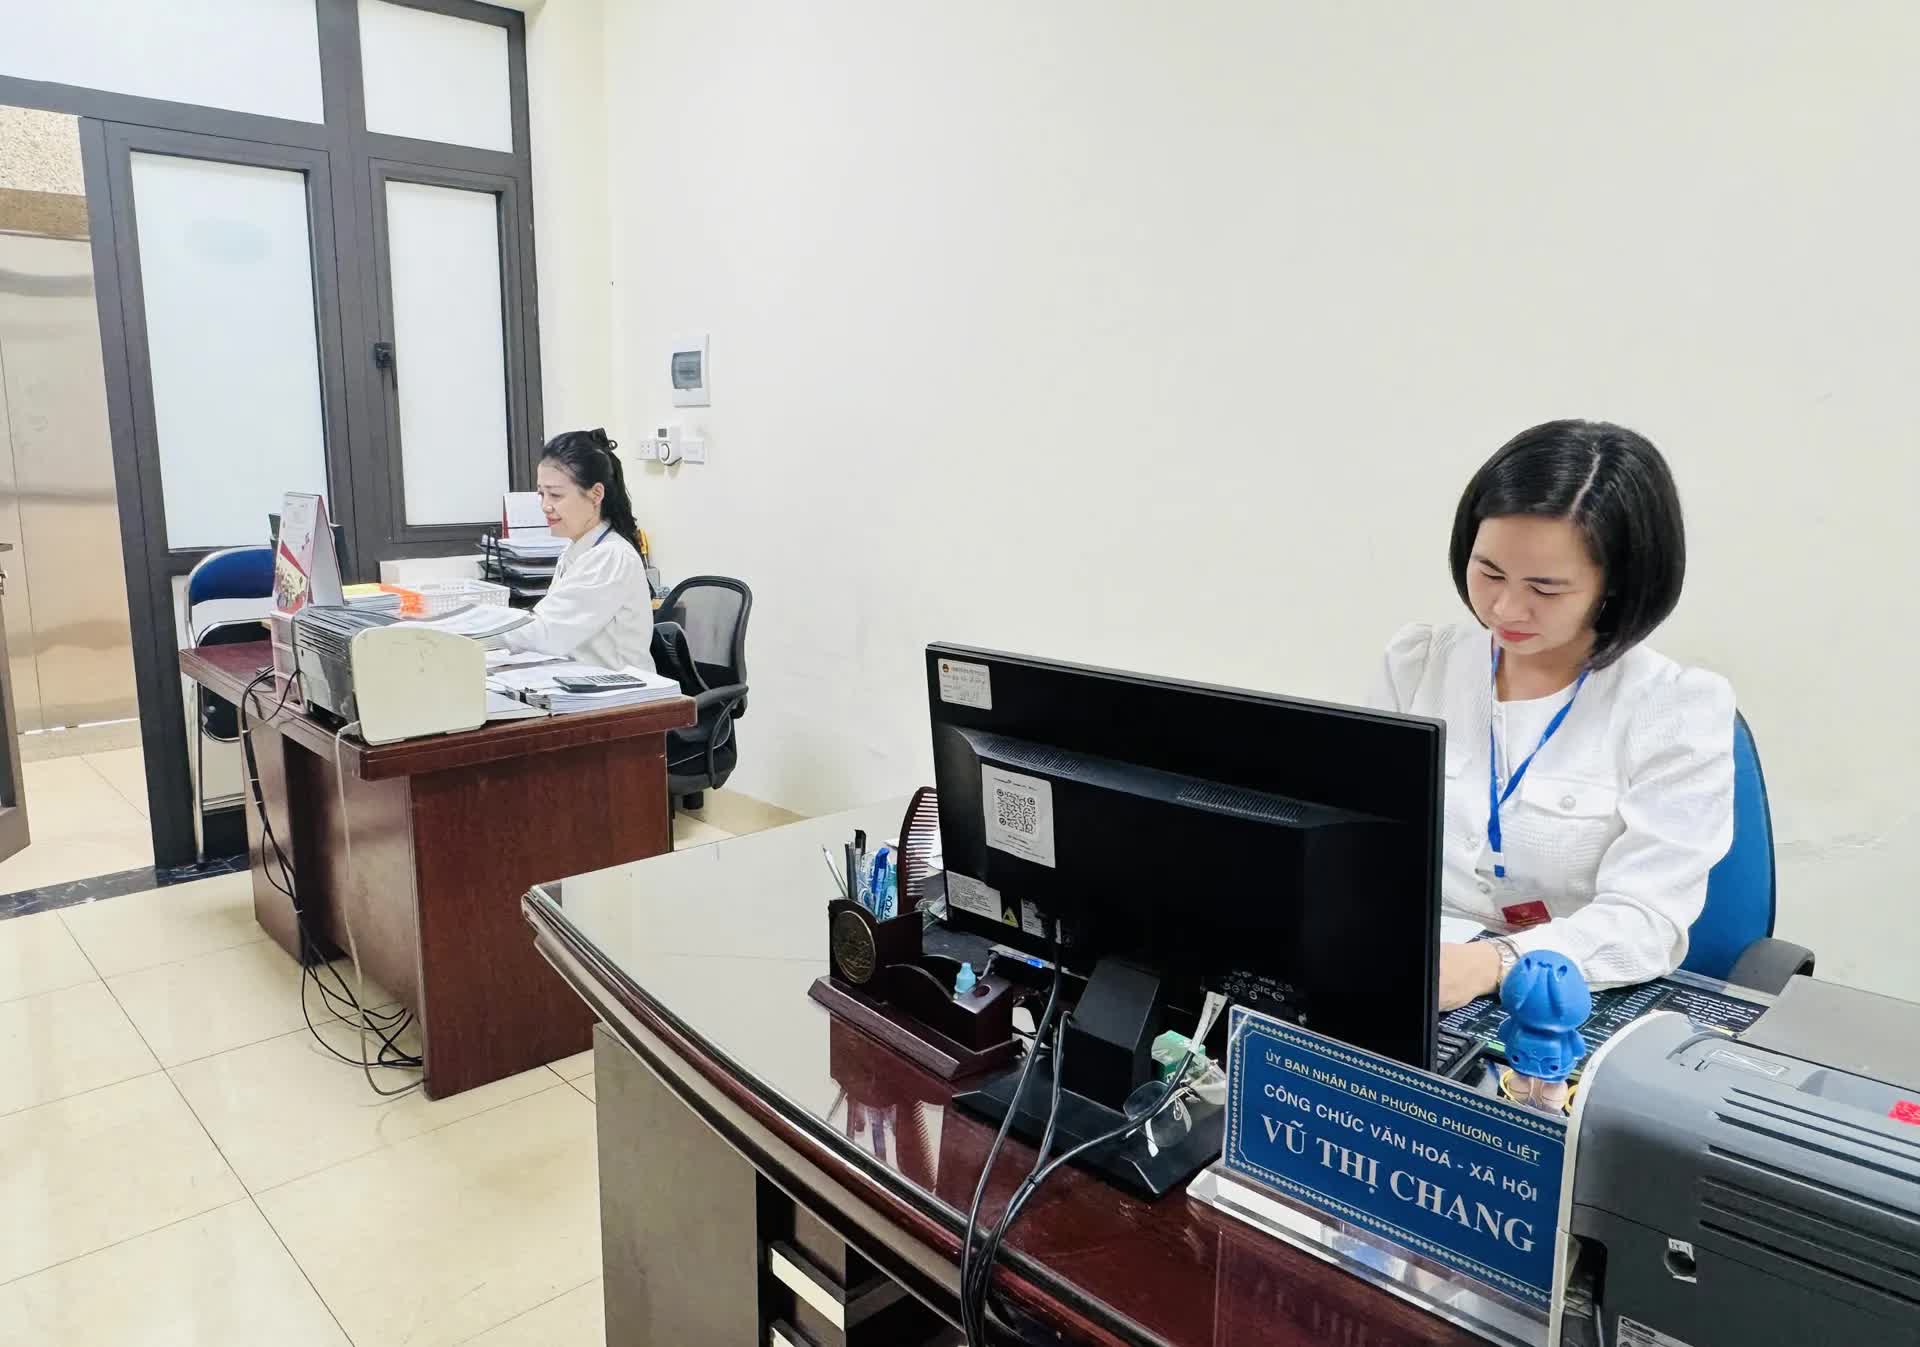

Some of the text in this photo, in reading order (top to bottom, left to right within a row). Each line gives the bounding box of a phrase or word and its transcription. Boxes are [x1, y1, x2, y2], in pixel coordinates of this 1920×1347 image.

[1264, 1084, 1311, 1112] CÔNG
[1316, 1104, 1364, 1132] CHỨC
[1370, 1123, 1406, 1149] VĂN
[1412, 1139, 1452, 1168] HOÁ
[1469, 1162, 1495, 1186] XÃ
[1502, 1175, 1537, 1202] HỘI
[1265, 1048, 1281, 1064] ỦY
[1284, 1058, 1309, 1075] BAN
[1312, 1069, 1347, 1089] NHÂN
[1350, 1083, 1377, 1100] DÂN
[1442, 1117, 1503, 1148] PHƯƠNG
[1508, 1141, 1541, 1161] LIỆT
[1260, 1113, 1536, 1252] VŨ THỊ CHANG
